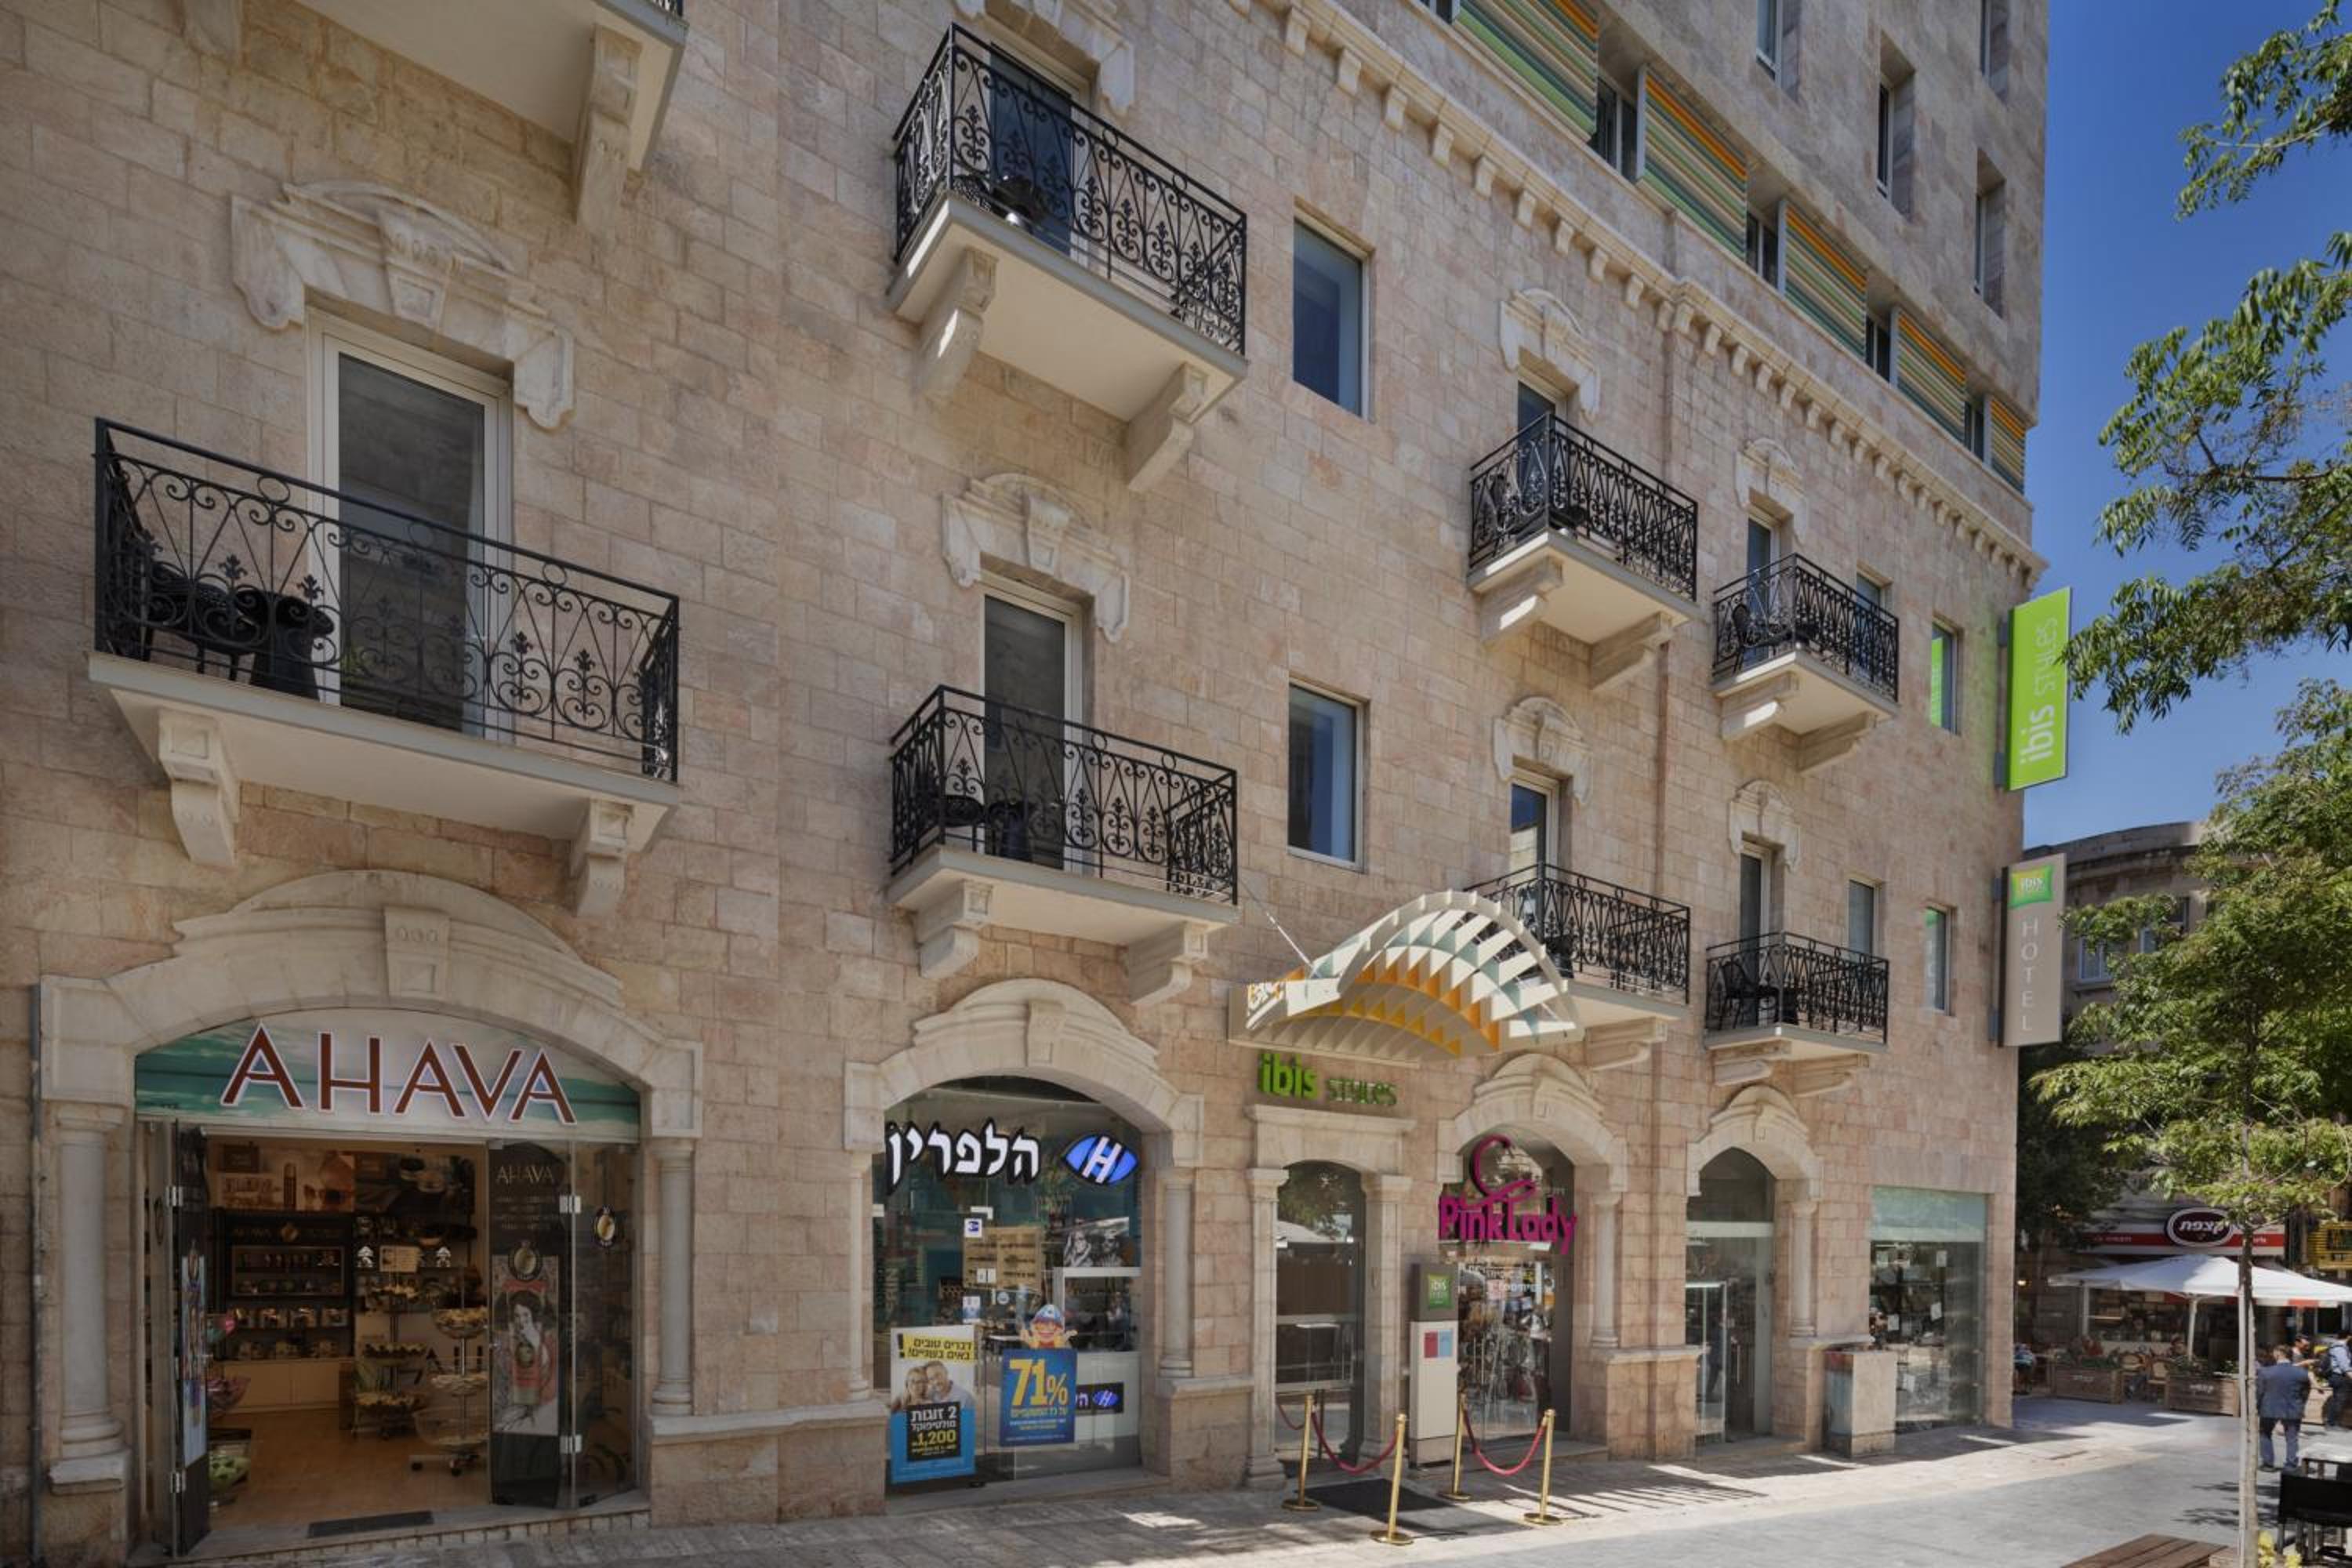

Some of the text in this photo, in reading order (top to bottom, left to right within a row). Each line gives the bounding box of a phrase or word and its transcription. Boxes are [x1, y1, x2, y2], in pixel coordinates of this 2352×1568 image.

[2019, 705, 2055, 765] ibis
[2020, 916, 2038, 1031] HOTEL
[220, 1022, 578, 1126] AHAVA
[1258, 1051, 1318, 1099] ibis
[887, 1120, 1040, 1188] הלפרין
[495, 1165, 554, 1185] AHAVA
[913, 1338, 942, 1349] טובים
[943, 1339, 972, 1351] דברים
[946, 1350, 971, 1360] באים
[1009, 1358, 1069, 1406] 71%
[910, 1406, 957, 1422] 2 זוגות
[917, 1429, 956, 1447] 1,200
